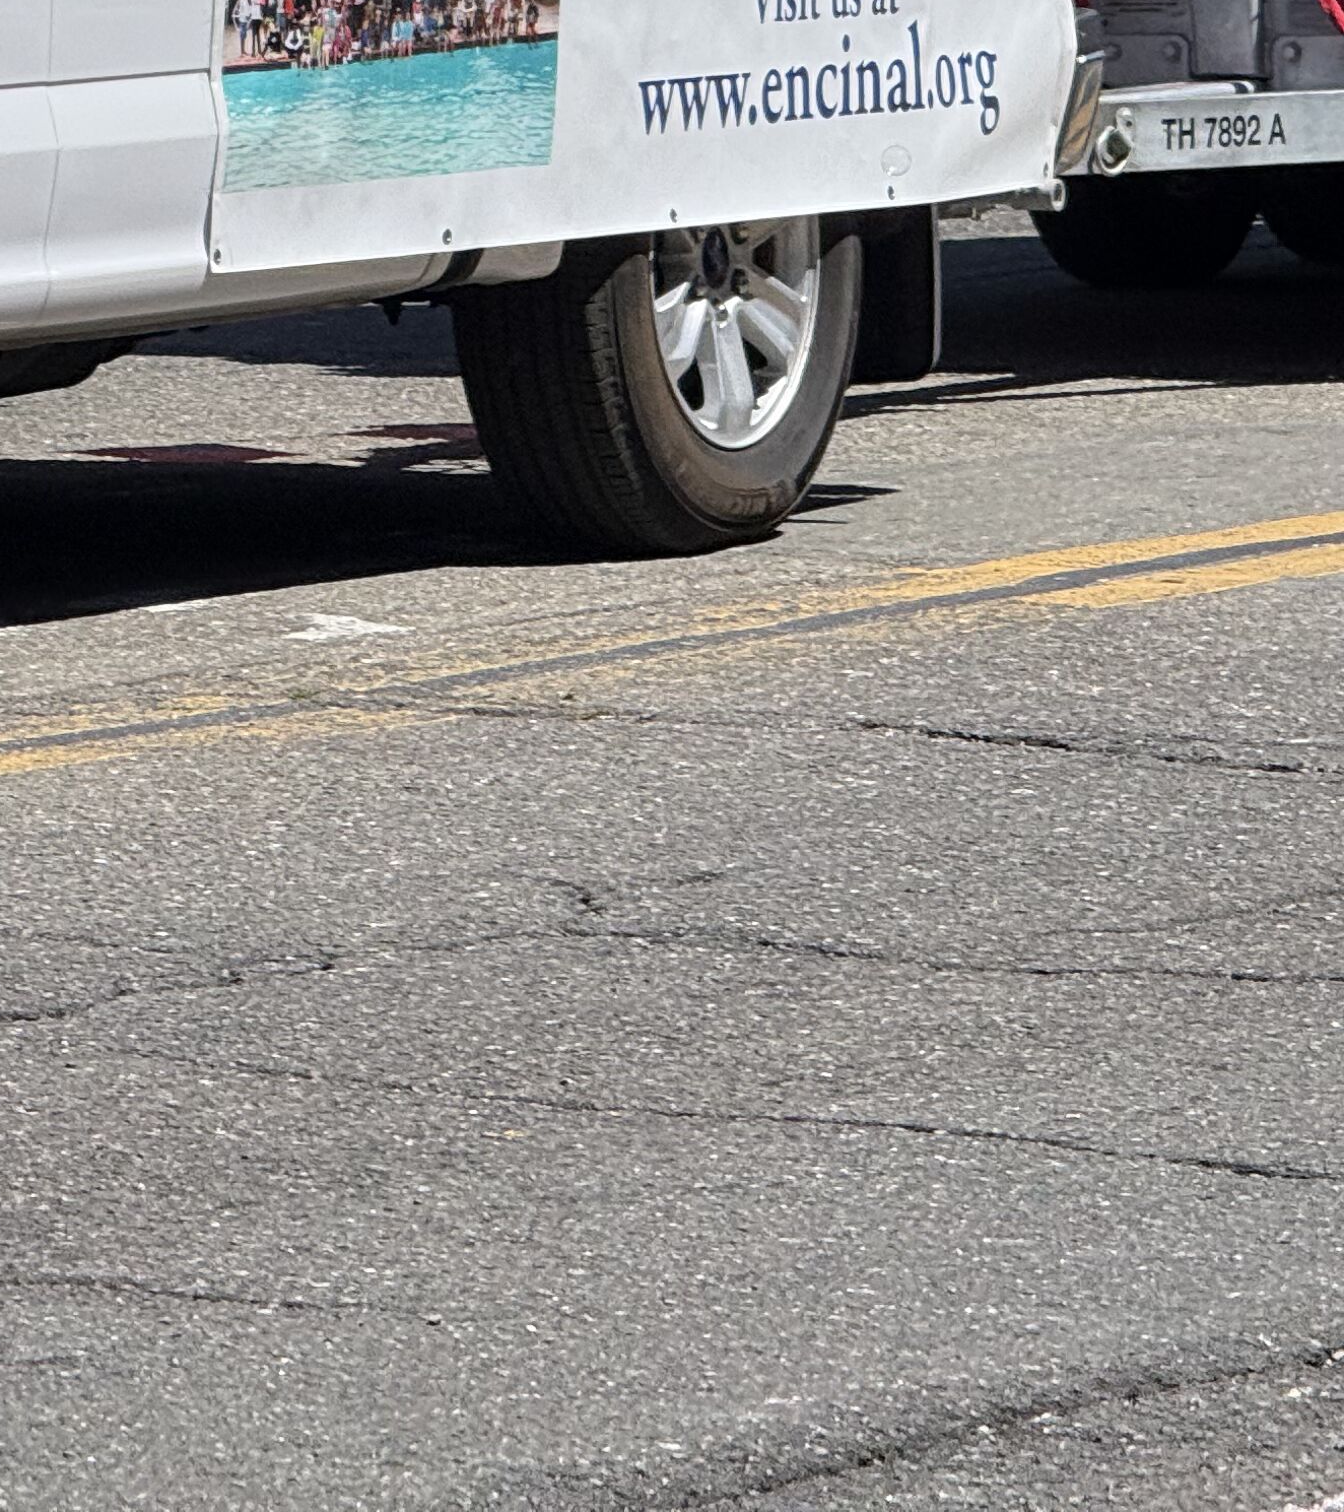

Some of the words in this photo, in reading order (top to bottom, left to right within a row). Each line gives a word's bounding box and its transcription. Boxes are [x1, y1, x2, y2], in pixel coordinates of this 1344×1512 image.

[638, 23, 1002, 136] www.encinal.org
[1161, 118, 1196, 150] TH
[1204, 115, 1261, 148] 7892
[1268, 113, 1287, 146] A
